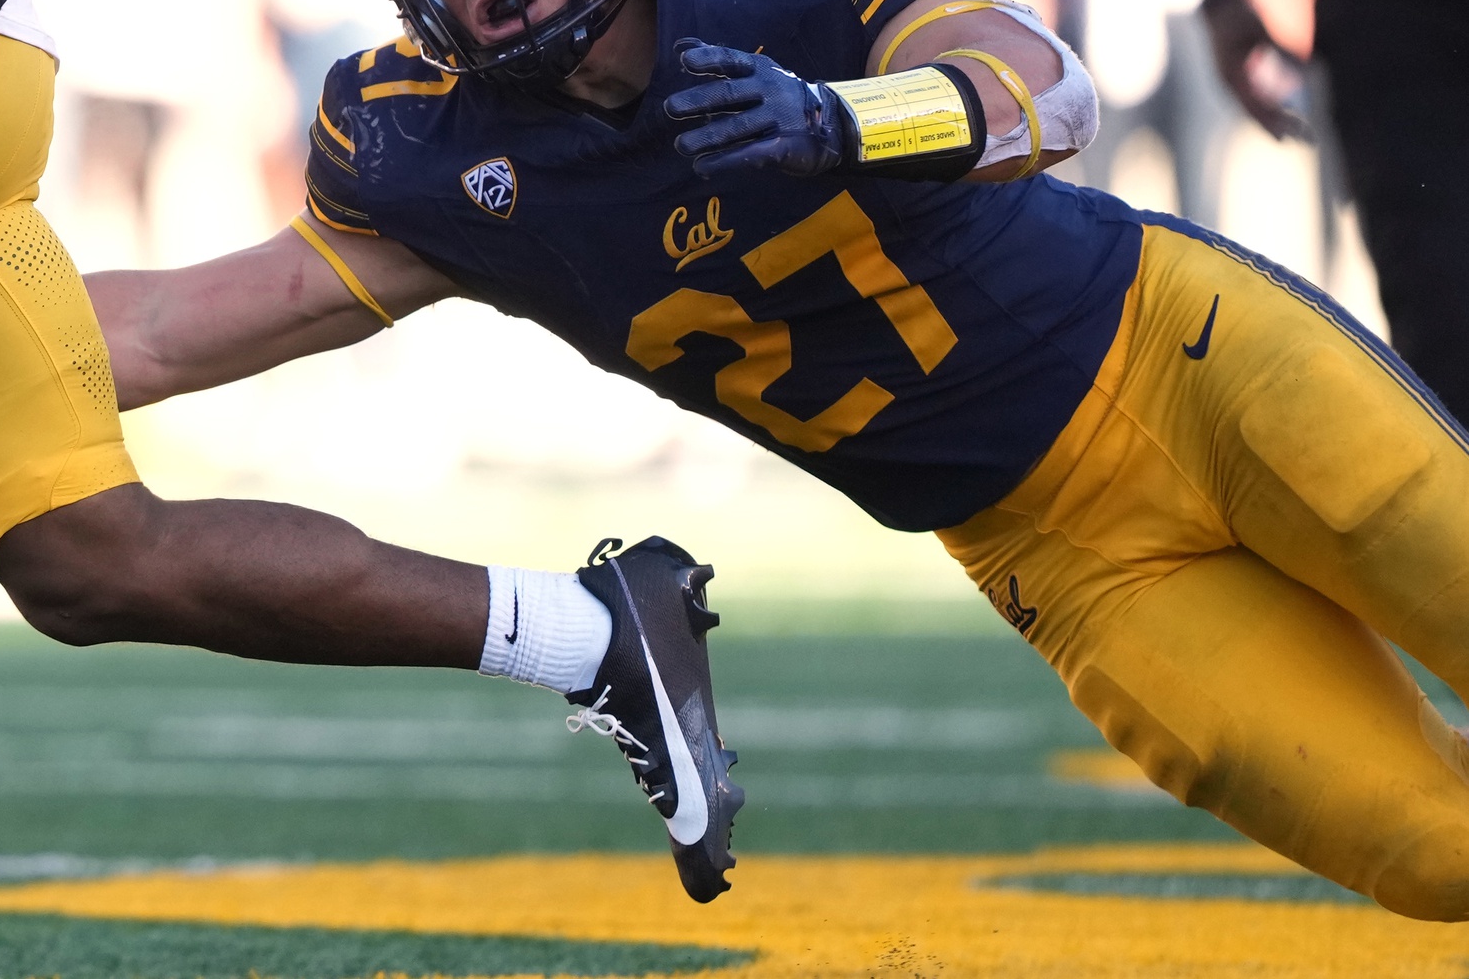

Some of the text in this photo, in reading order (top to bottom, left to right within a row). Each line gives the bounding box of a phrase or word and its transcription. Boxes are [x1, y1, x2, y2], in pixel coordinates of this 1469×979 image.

[852, 93, 886, 104] DIAMOND
[937, 131, 955, 140] SHADE
[865, 143, 880, 151] PAM
[882, 141, 896, 149] KICK
[464, 160, 513, 203] PAC
[483, 184, 511, 210] 12
[663, 196, 734, 272] Cal
[626, 189, 958, 453] 27
